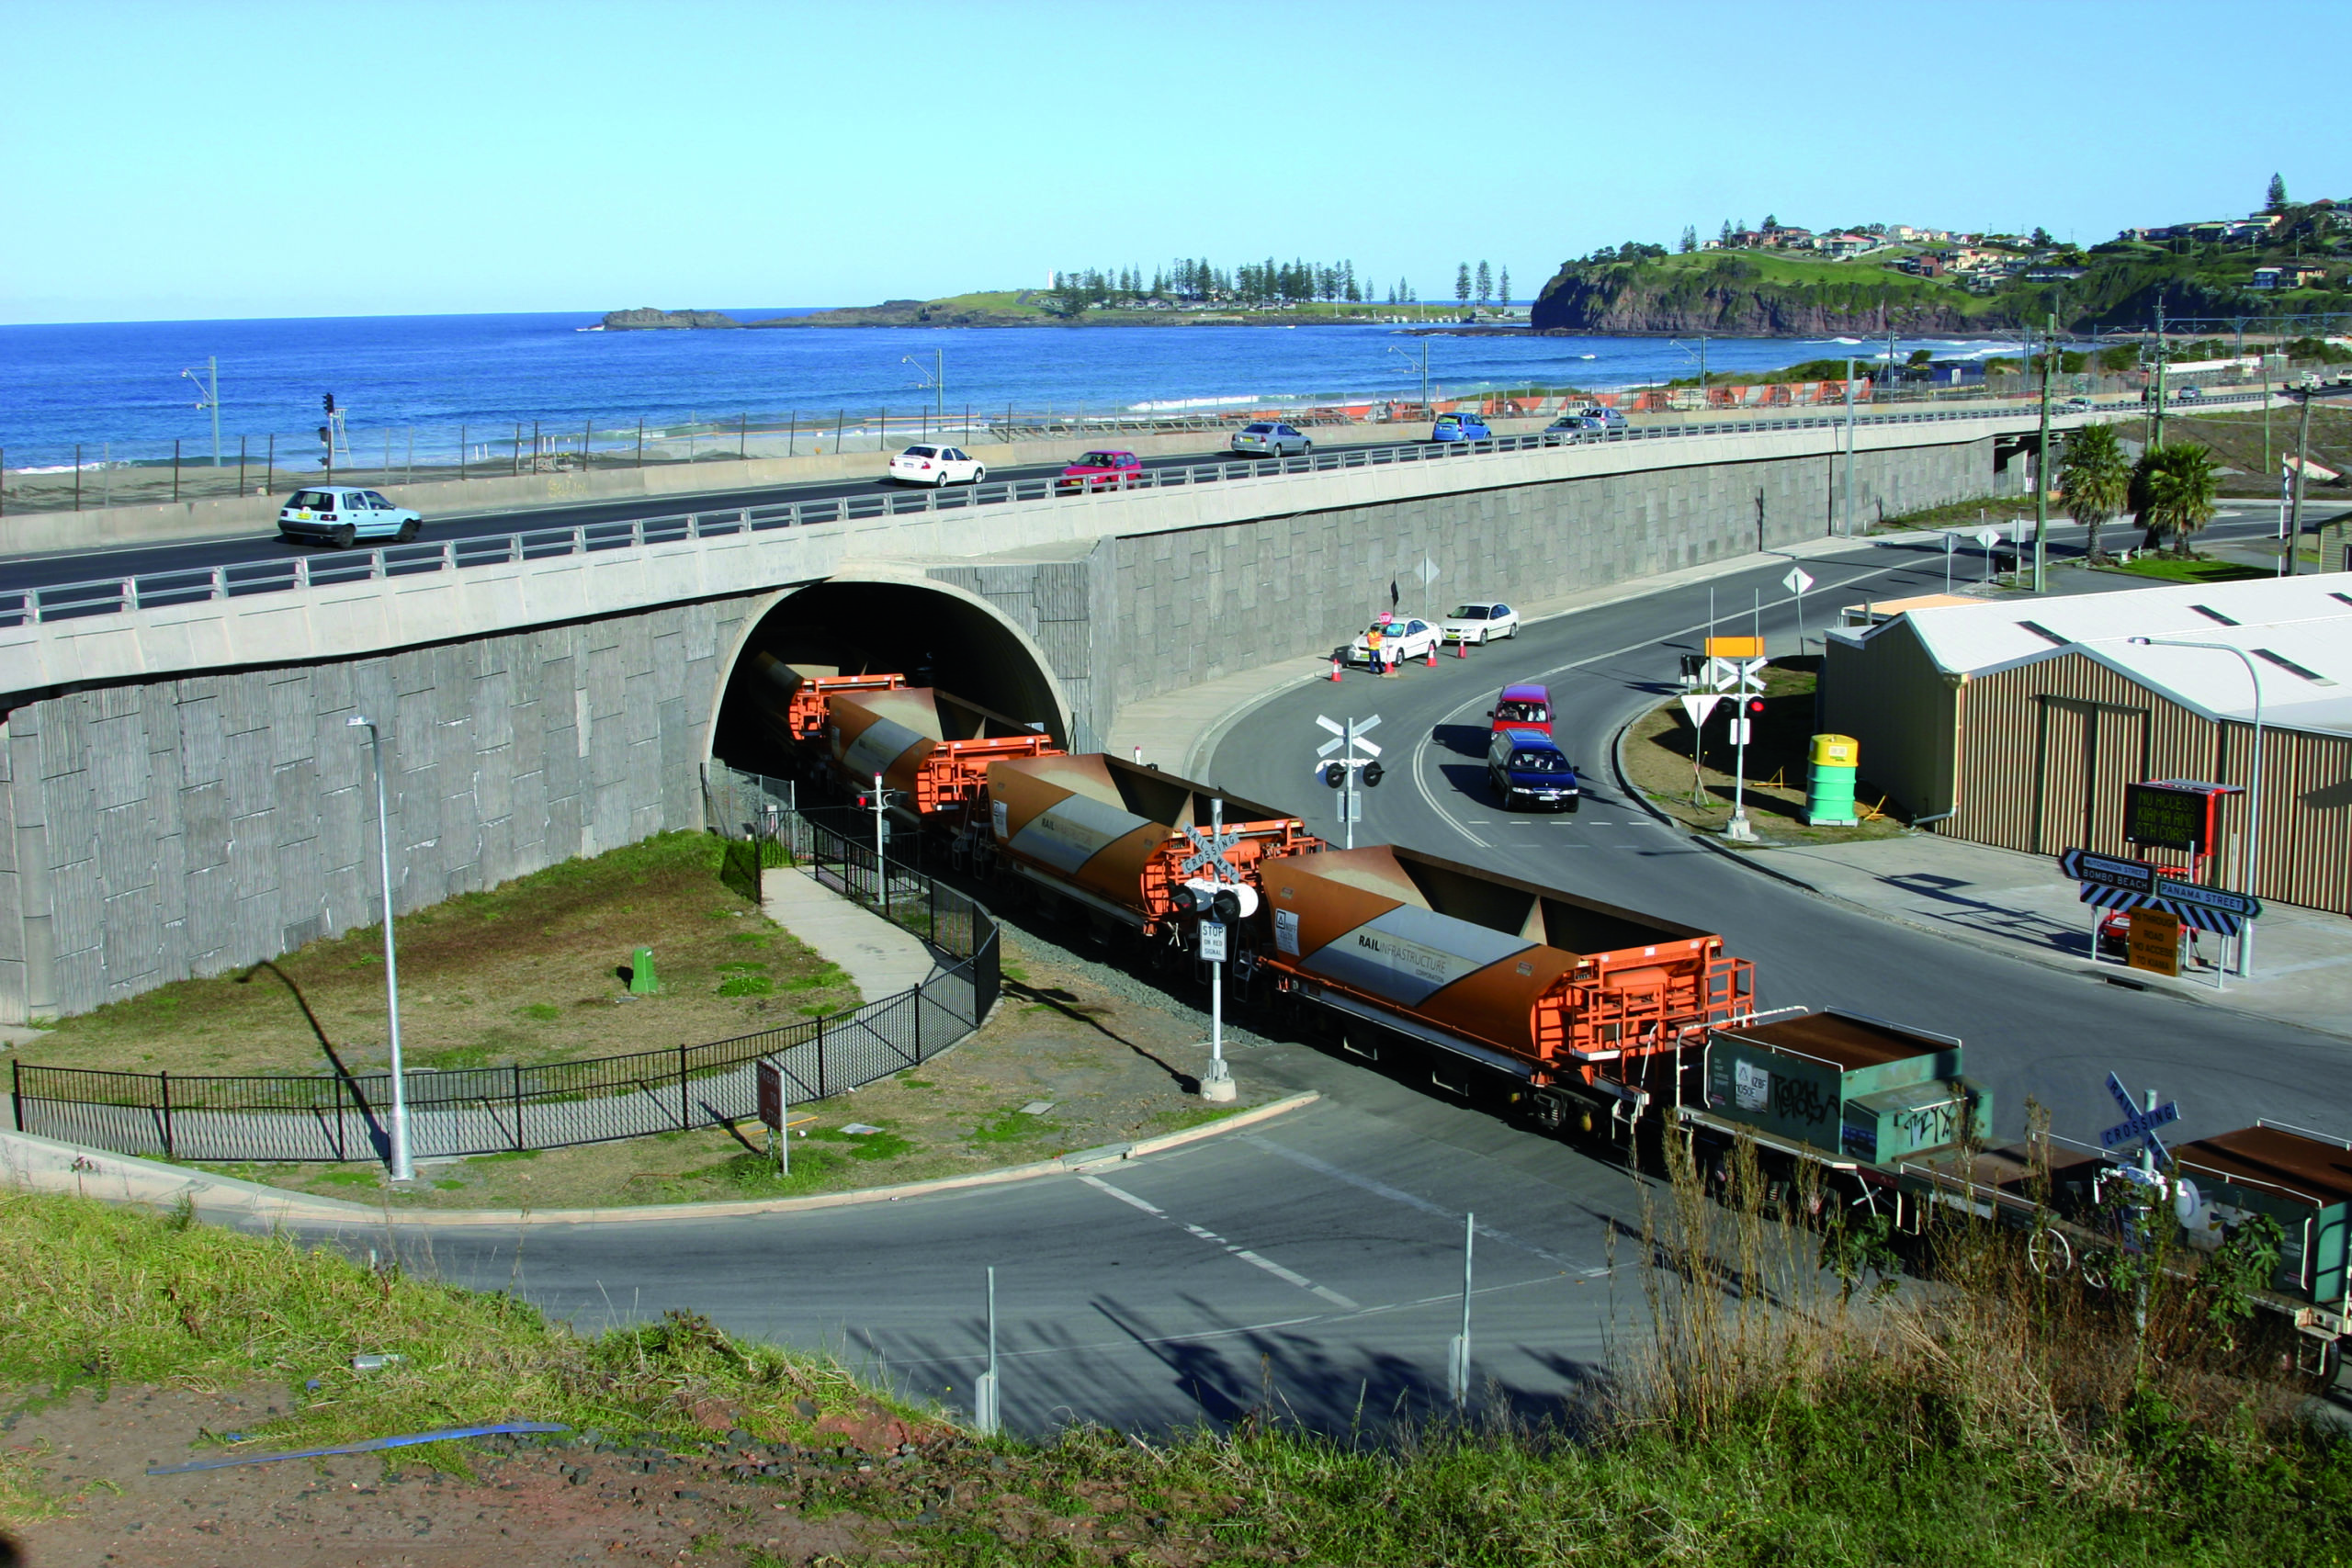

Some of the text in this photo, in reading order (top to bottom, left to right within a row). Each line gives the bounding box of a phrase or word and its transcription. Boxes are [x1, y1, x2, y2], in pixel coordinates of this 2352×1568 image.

[2139, 792, 2197, 812] NO ACCESS
[2137, 807, 2195, 829] KIAMA AND
[2135, 822, 2195, 842] STH COAST
[1185, 826, 1236, 878] RAIL WAY
[1185, 835, 1235, 872] CROSSING
[2083, 869, 2148, 890] BOMBO BEACH
[2123, 864, 2148, 877] STREET
[2161, 884, 2242, 908] PANAMA STREET
[1203, 925, 1224, 937] STOP
[2143, 930, 2165, 942] ROAD
[2133, 942, 2174, 958] NO ACCESS
[2136, 955, 2170, 970] TO KIAMA
[2109, 1081, 2133, 1120] RAIL
[2106, 1106, 2173, 1145] CROSSING
